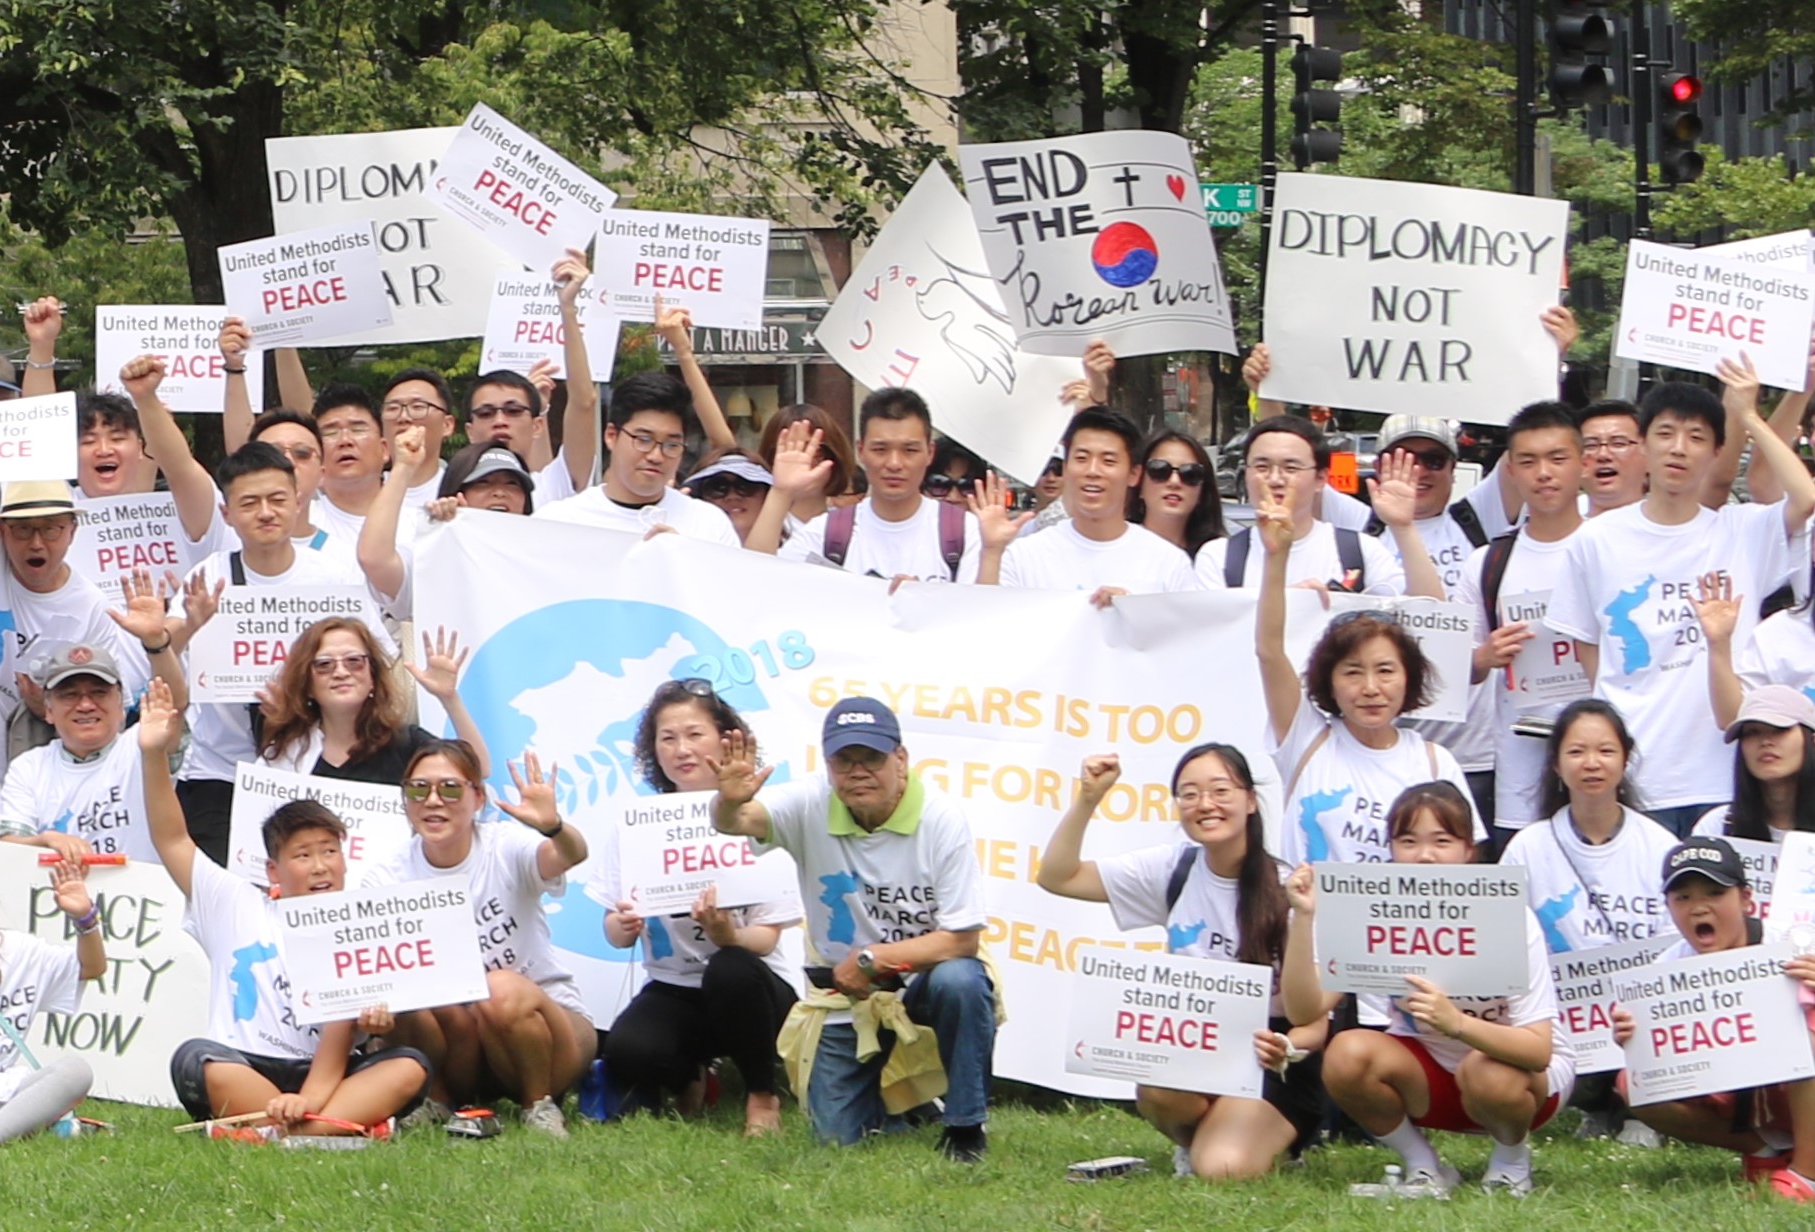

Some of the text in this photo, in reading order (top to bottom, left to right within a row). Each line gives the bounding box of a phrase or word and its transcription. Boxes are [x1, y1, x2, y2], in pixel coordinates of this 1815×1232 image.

[274, 160, 439, 203] DIPLOM
[981, 149, 1087, 205] END
[1203, 188, 1251, 207] K ST
[603, 220, 762, 246] United Methodists
[997, 204, 1102, 245] THE
[1279, 209, 1555, 275] DIPLOMACY
[640, 243, 721, 262] stand for
[634, 263, 723, 293] PEACE
[1002, 250, 1140, 328] Korean
[1635, 252, 1810, 301] United Methodists
[1371, 286, 1462, 326] NOT
[1676, 282, 1764, 312] stand for
[703, 329, 714, 351] A
[721, 327, 789, 351] MANGER
[1667, 304, 1765, 344] PEACE
[1342, 337, 1472, 383] WAR
[691, 630, 816, 692] 2018
[878, 681, 1043, 728] YEARS
[1054, 694, 1090, 737] IS
[1098, 703, 1201, 744] TOO
[962, 762, 1061, 810] FOR
[1320, 875, 1519, 897] United Methodists
[1587, 893, 1658, 915] PEACE
[286, 889, 466, 930] United Methodists
[1370, 900, 1470, 920] stand for
[334, 917, 423, 945] stand for
[1366, 925, 1477, 956] PEACE
[334, 940, 435, 979] PEACE
[45, 1010, 145, 1057] NOW
